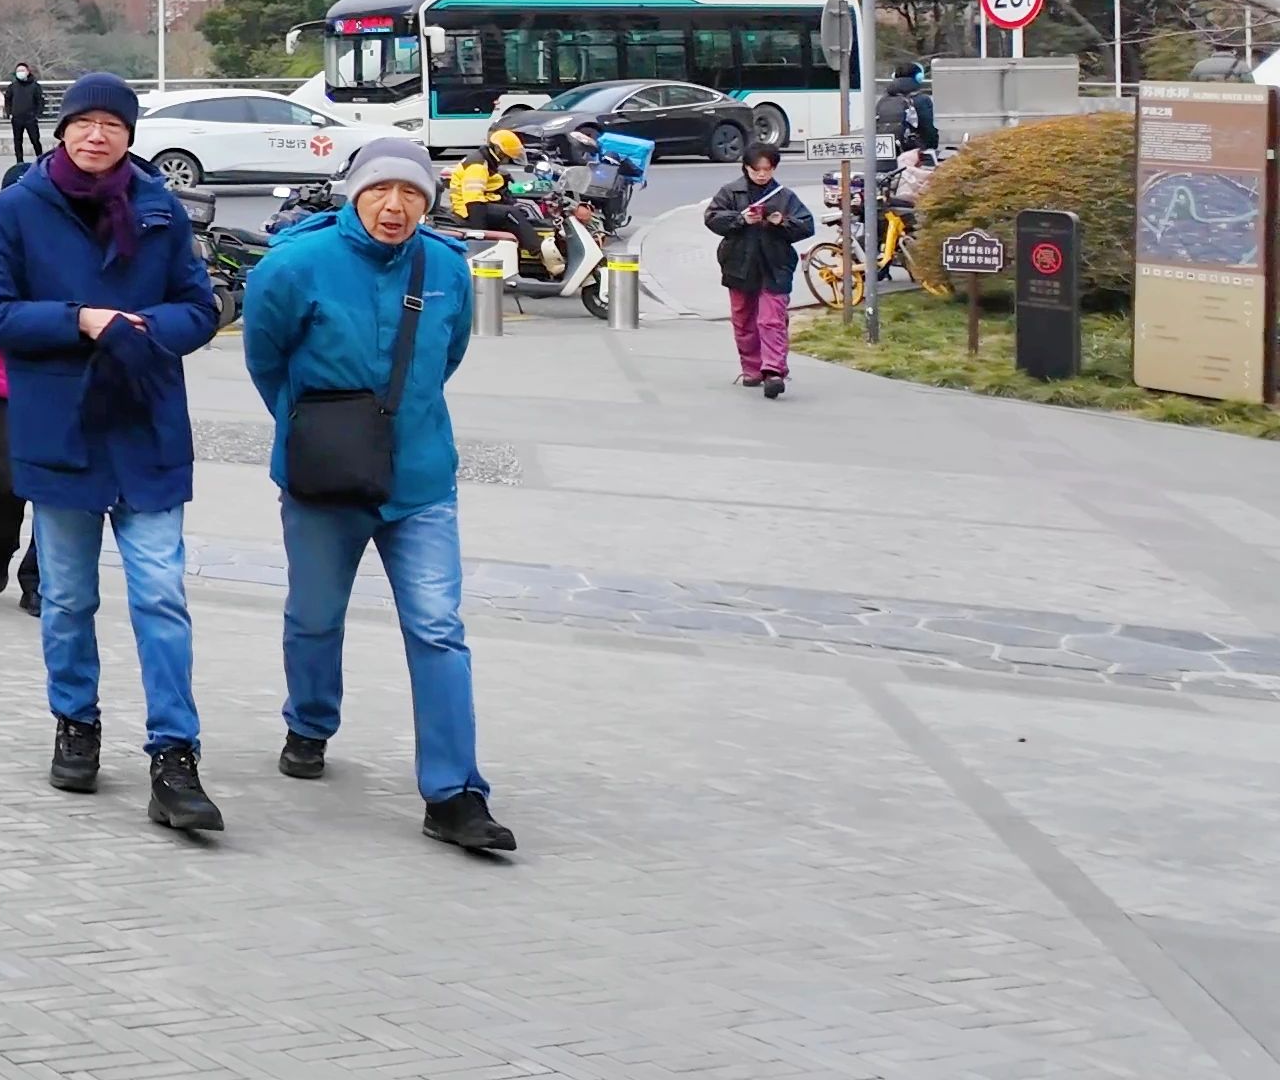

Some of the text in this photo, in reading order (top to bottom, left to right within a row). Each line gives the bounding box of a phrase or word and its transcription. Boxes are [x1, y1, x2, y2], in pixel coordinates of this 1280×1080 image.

[812, 140, 889, 157] 特种车辆外
